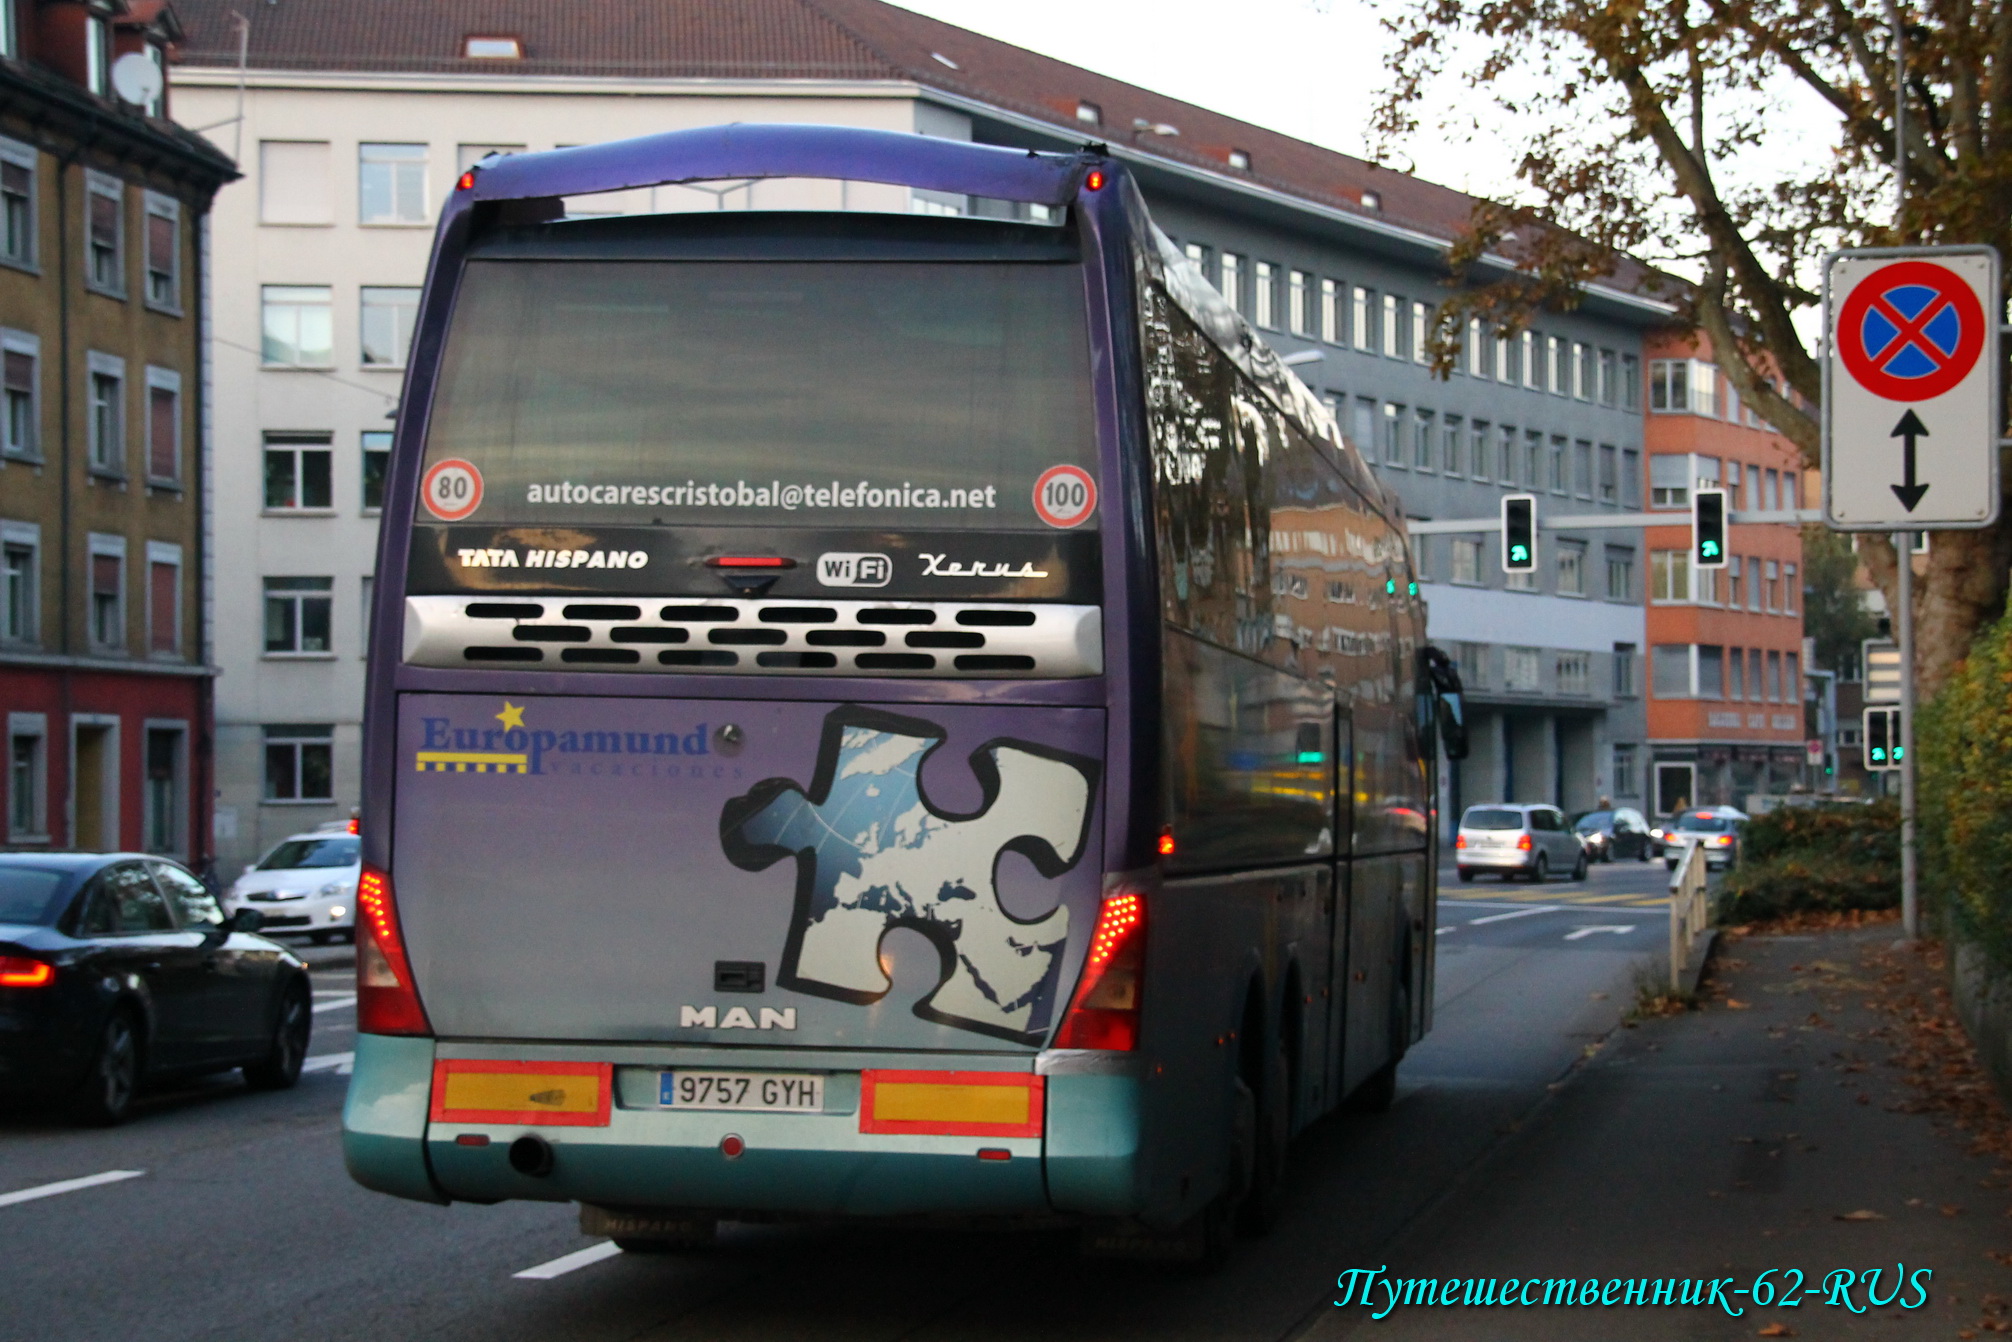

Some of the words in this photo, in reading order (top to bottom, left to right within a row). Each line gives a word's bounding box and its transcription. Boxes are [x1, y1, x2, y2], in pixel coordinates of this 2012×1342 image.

[438, 476, 468, 499] 80
[527, 479, 997, 510] autocarescristobal@telefonica.net
[1046, 482, 1085, 507] 100
[457, 549, 519, 568] TATA
[525, 550, 649, 570] HISPANO
[917, 553, 1049, 578] Xerus
[680, 1005, 797, 1030] MAN
[680, 1076, 750, 1104] 9757
[762, 1079, 815, 1106] GYH
